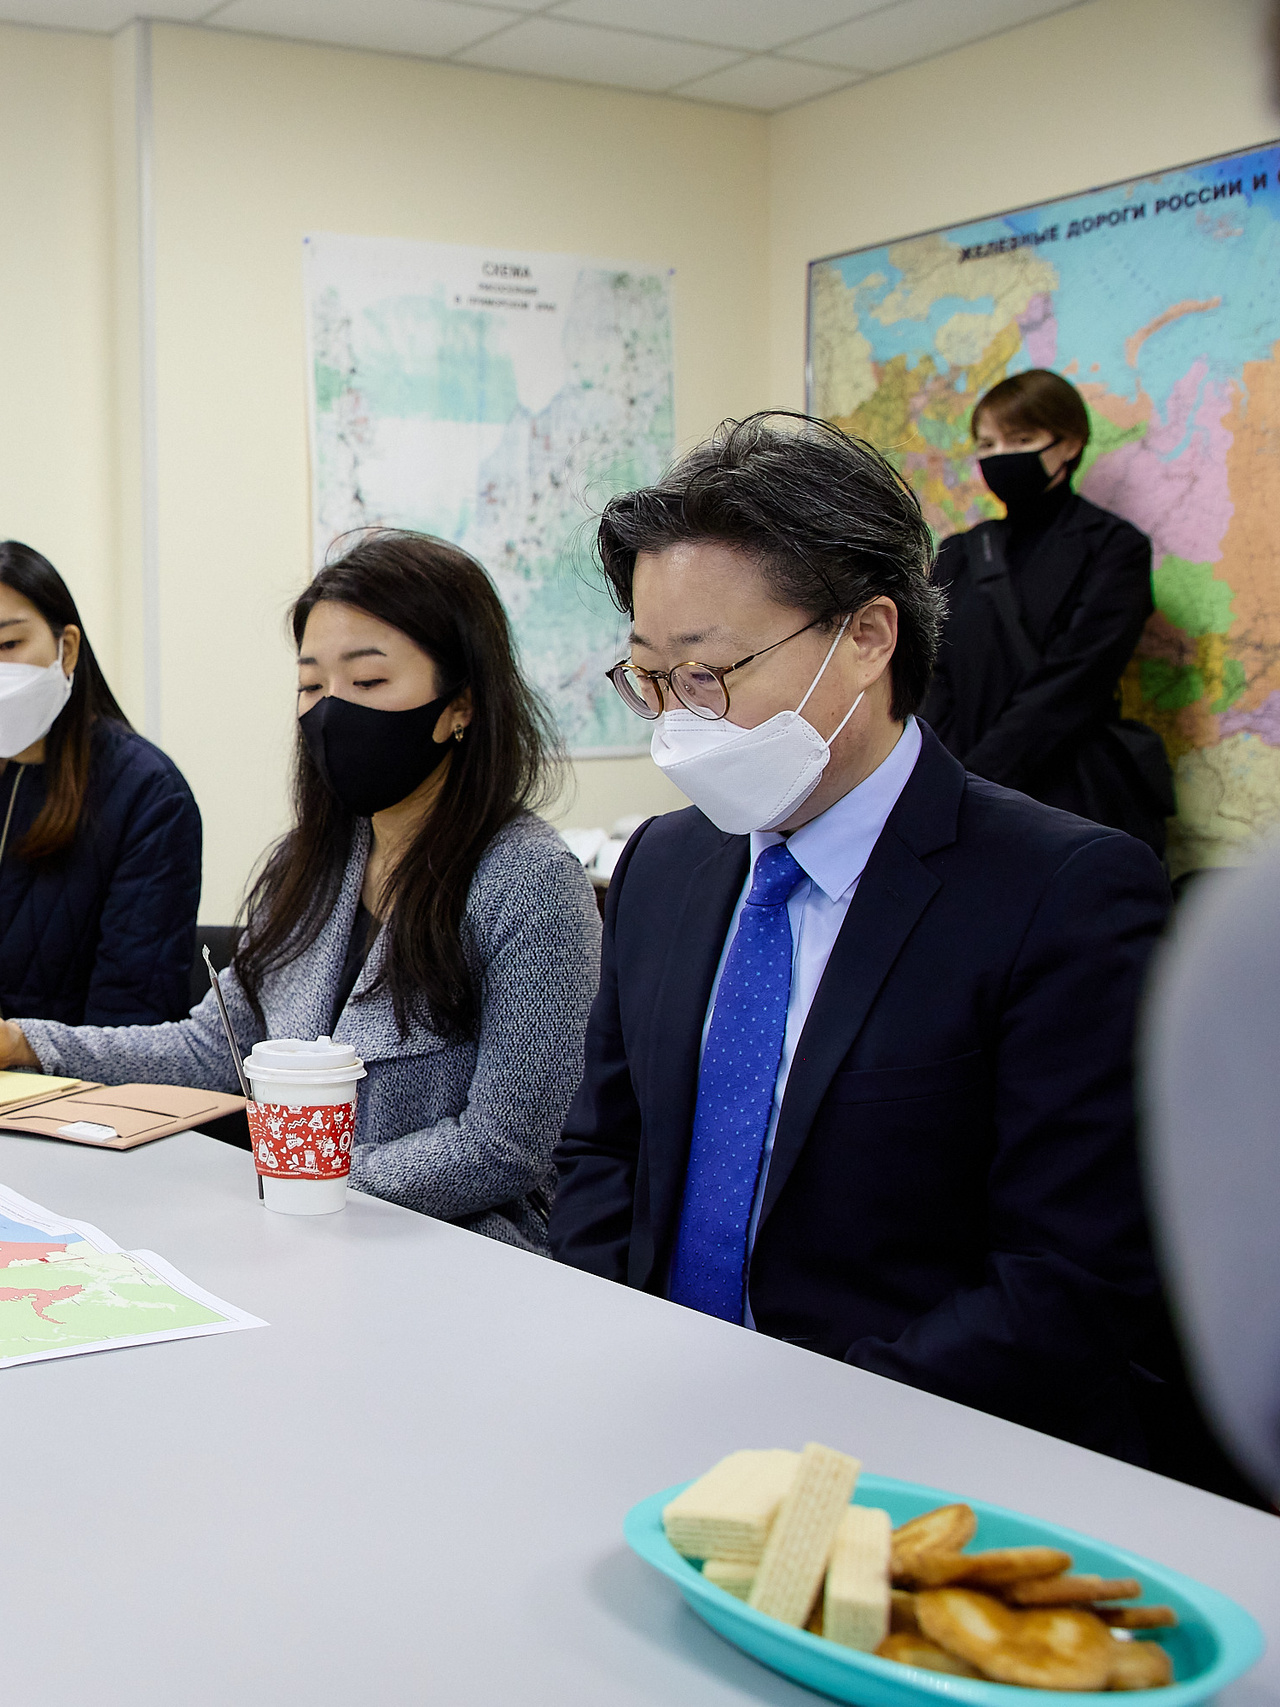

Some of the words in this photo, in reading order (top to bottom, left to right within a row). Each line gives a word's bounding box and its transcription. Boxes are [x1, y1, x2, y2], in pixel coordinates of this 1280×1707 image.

[959, 223, 1060, 263] ЖЕЛЕЗНЫЕ
[1066, 203, 1146, 239] ДОРОГИ
[1155, 178, 1242, 214] РОССИИ
[1252, 172, 1268, 191] И
